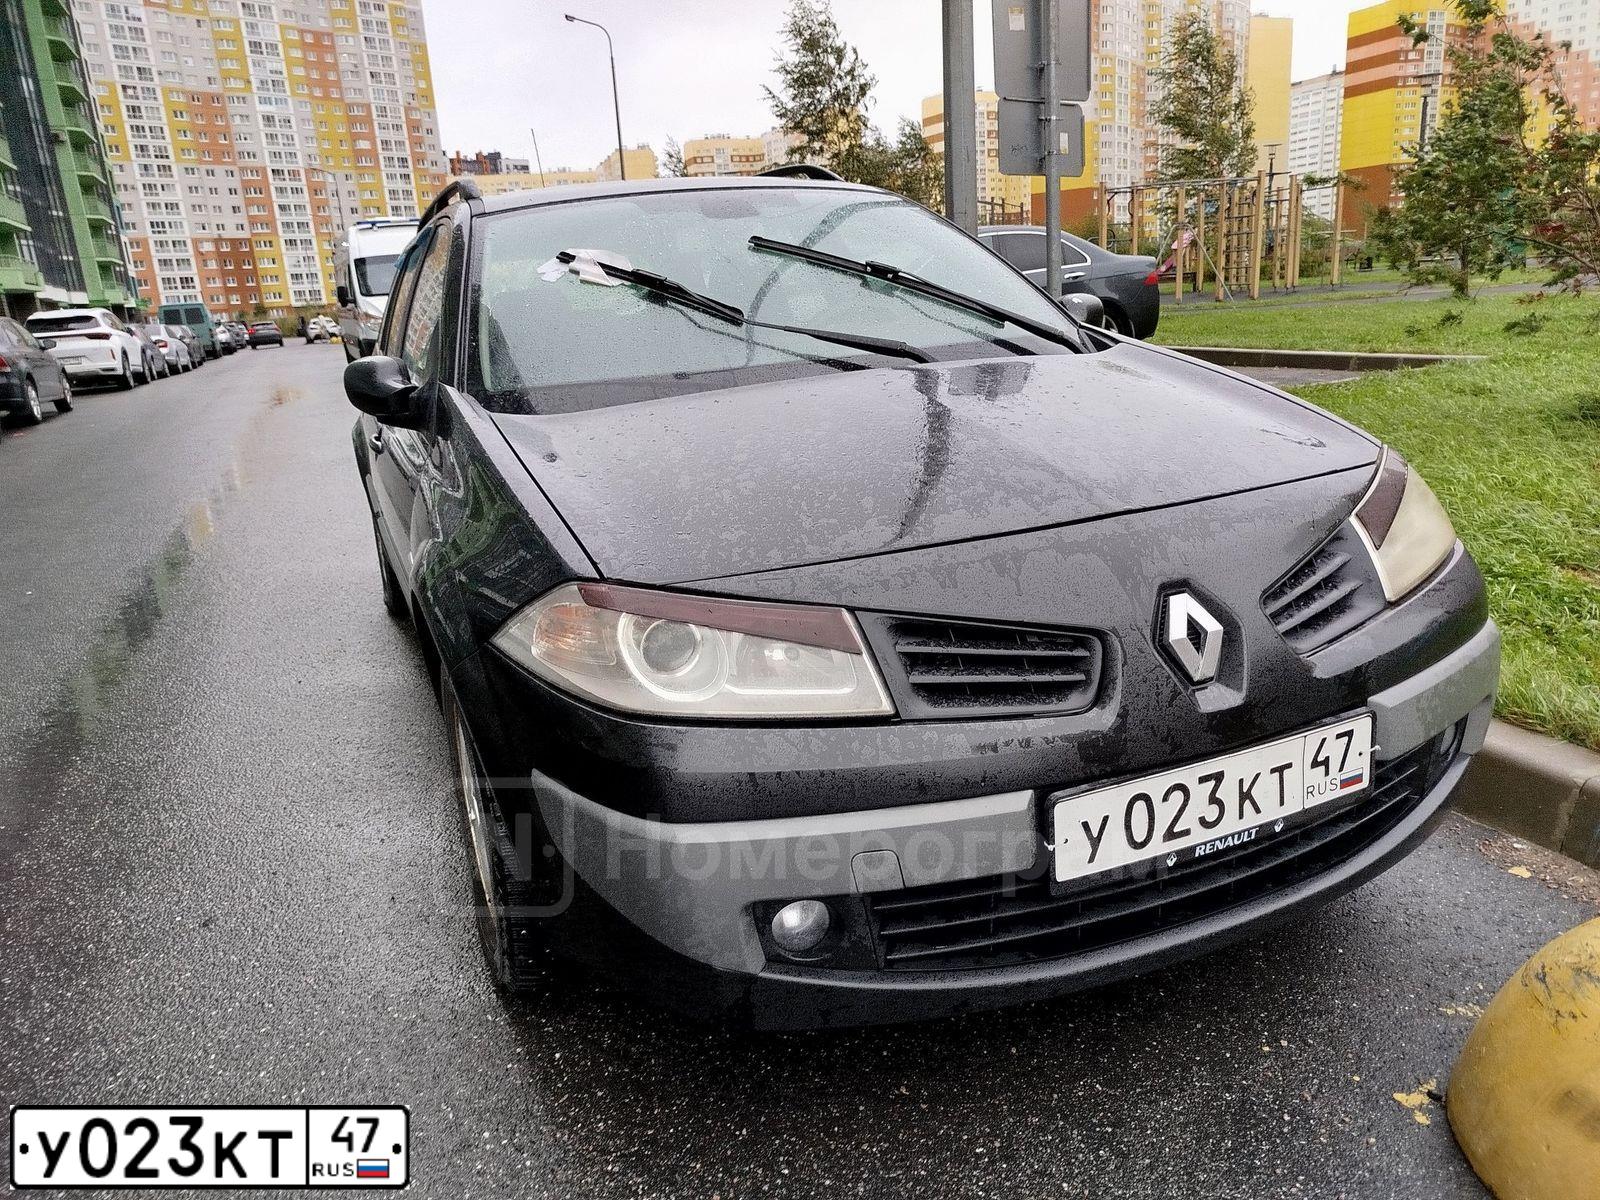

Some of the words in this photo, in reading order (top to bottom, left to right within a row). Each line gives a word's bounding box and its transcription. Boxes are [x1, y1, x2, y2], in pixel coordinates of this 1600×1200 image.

[1310, 728, 1356, 776] 47
[1305, 776, 1339, 800] RUS
[1194, 826, 1260, 858] RENAULT
